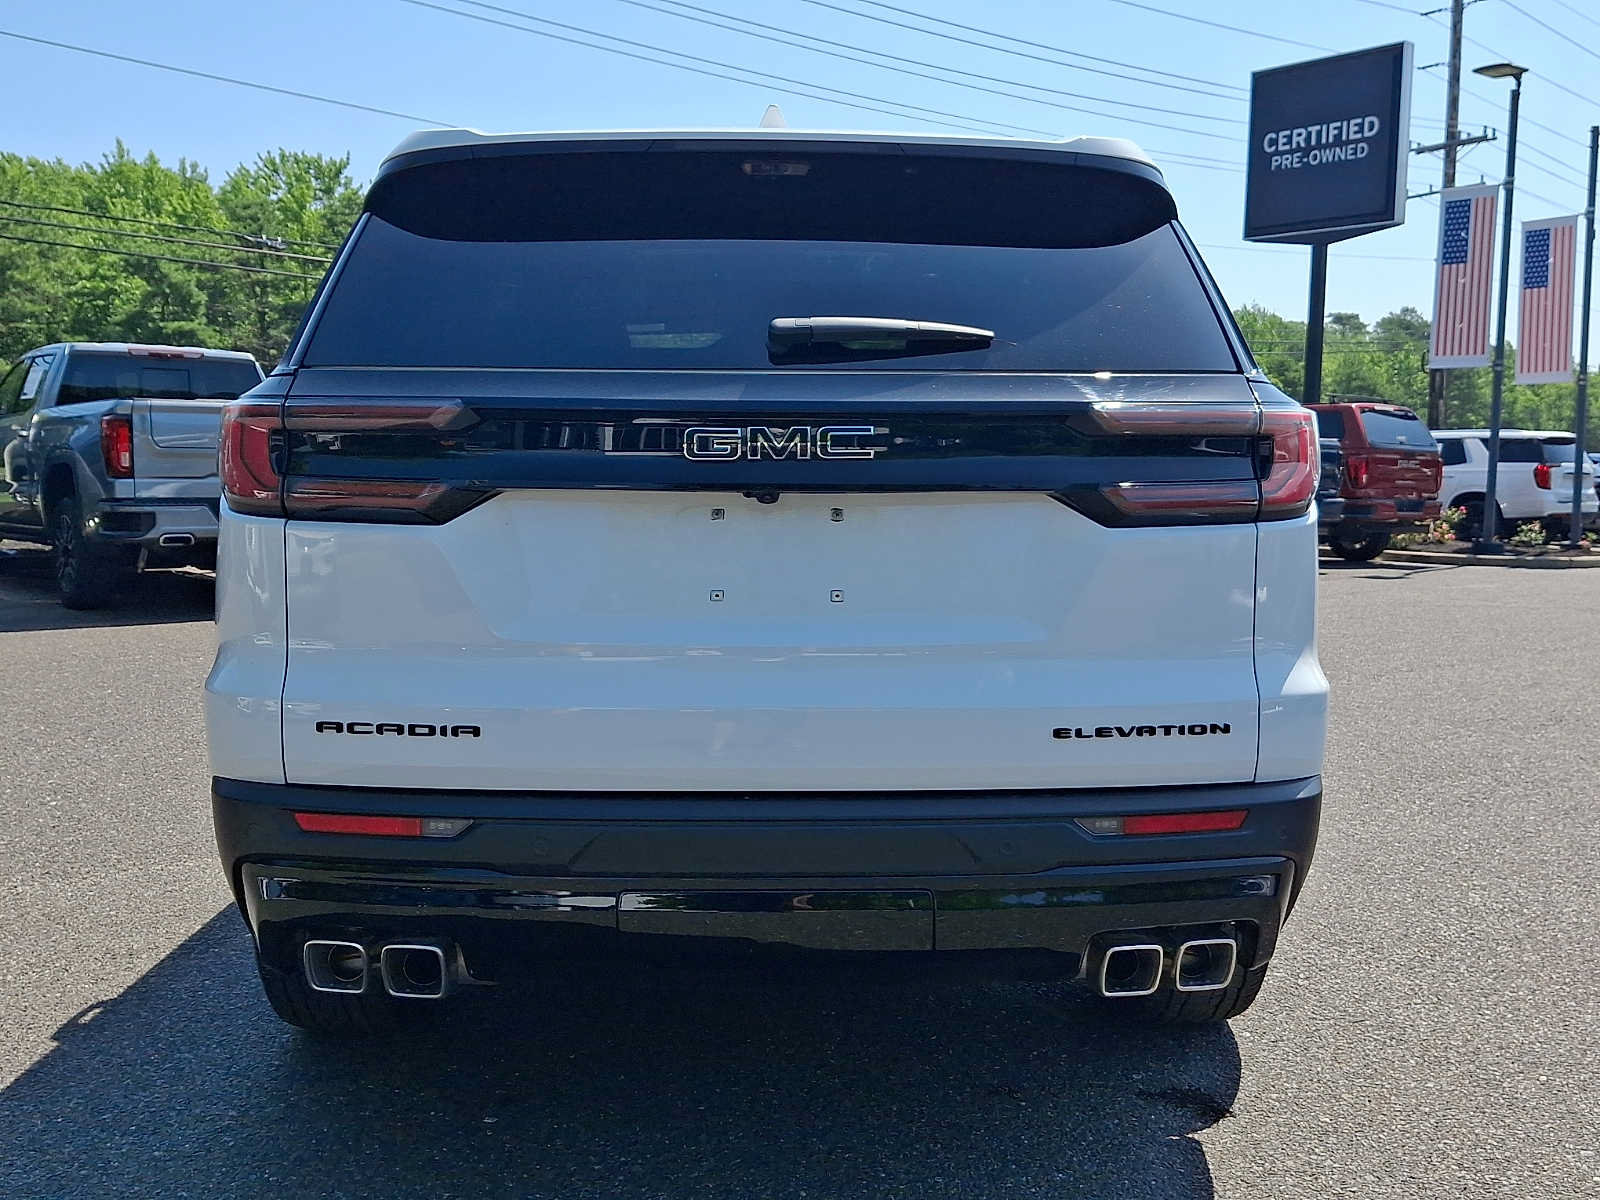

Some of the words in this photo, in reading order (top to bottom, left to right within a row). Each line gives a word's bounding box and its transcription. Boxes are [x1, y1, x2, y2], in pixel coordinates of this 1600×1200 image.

[1263, 116, 1379, 153] CERTIFIED
[1271, 142, 1369, 171] PRE-OWNED
[684, 426, 875, 461] GMC
[315, 721, 481, 738] ACADIA
[1052, 722, 1231, 739] ELEVATION
